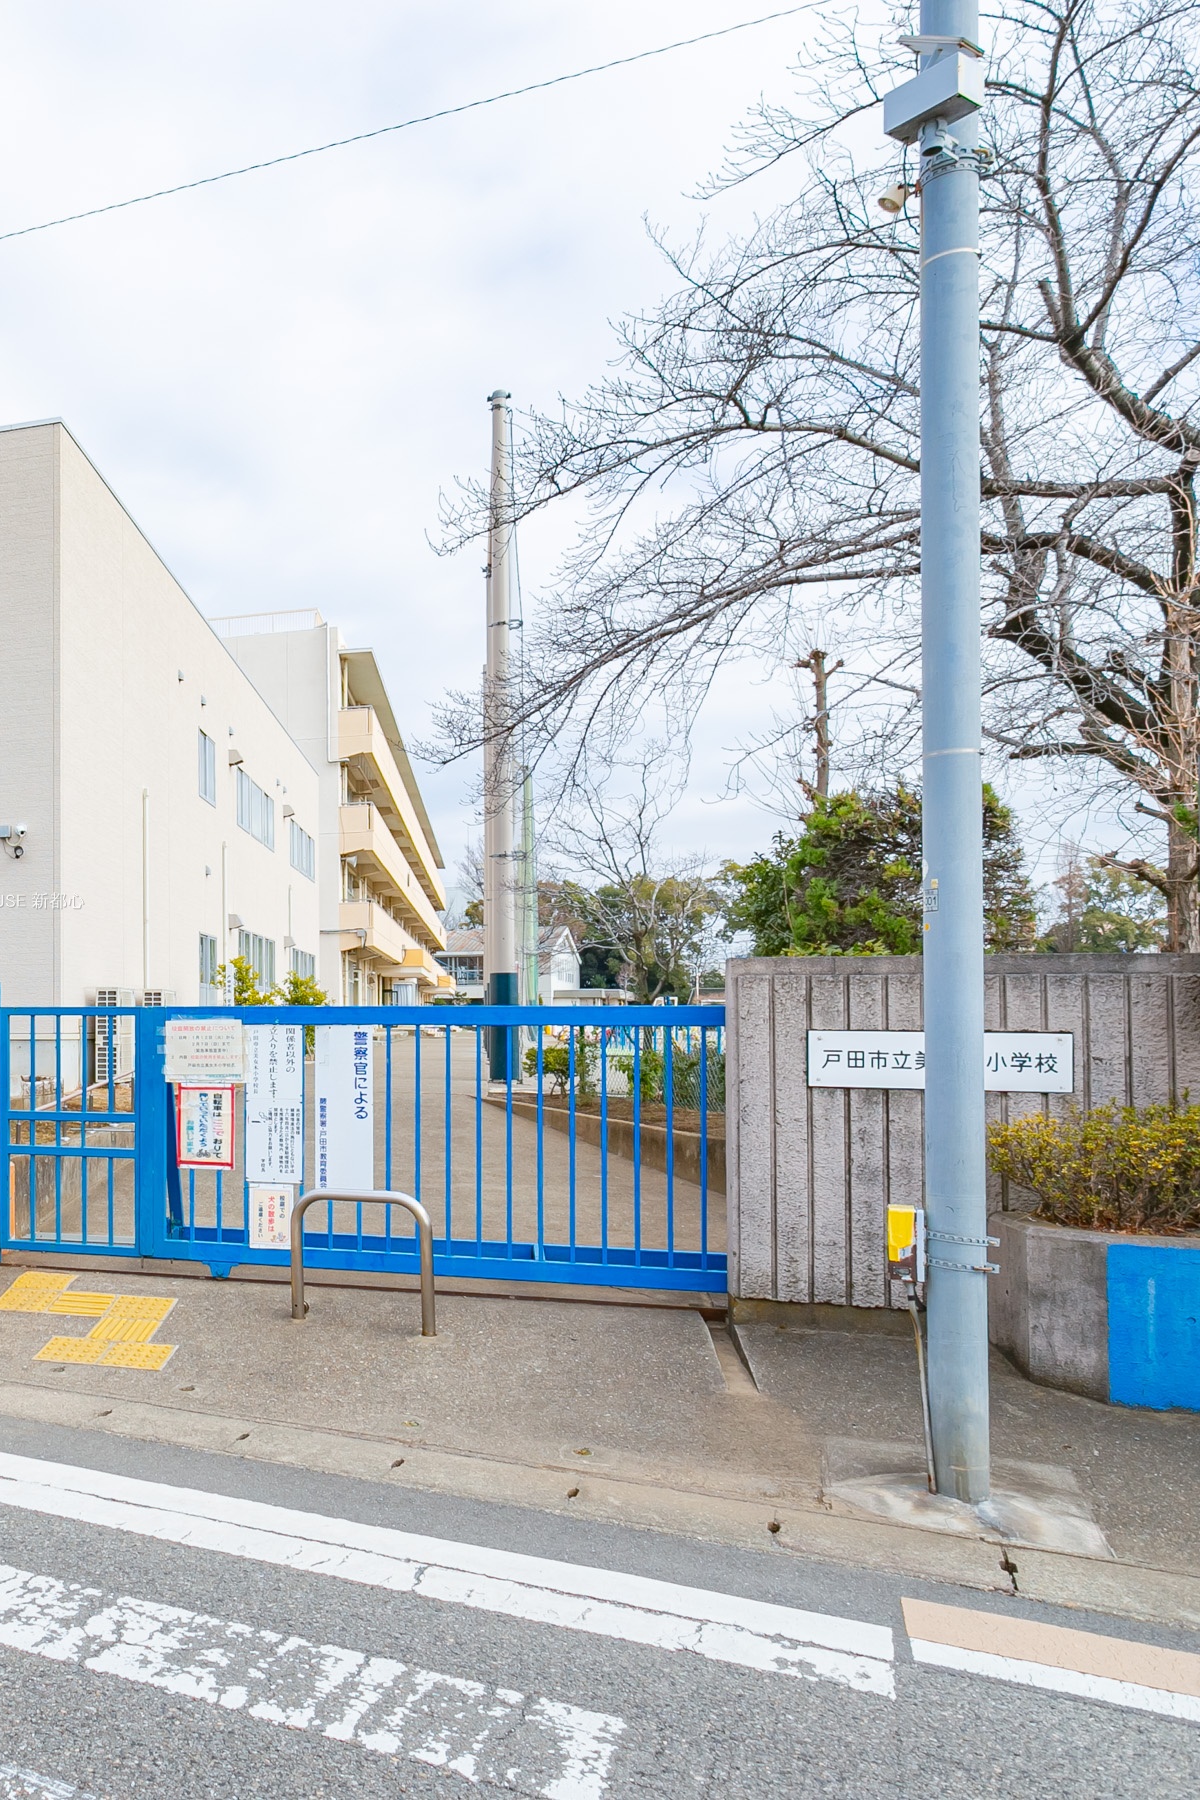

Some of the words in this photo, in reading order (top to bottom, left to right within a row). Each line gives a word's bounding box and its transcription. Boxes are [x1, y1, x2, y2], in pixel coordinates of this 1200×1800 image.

[285, 1027, 296, 1073] 関係者以外の
[353, 1031, 369, 1120] 警察官による
[267, 1195, 275, 1232] 犬の散歩は
